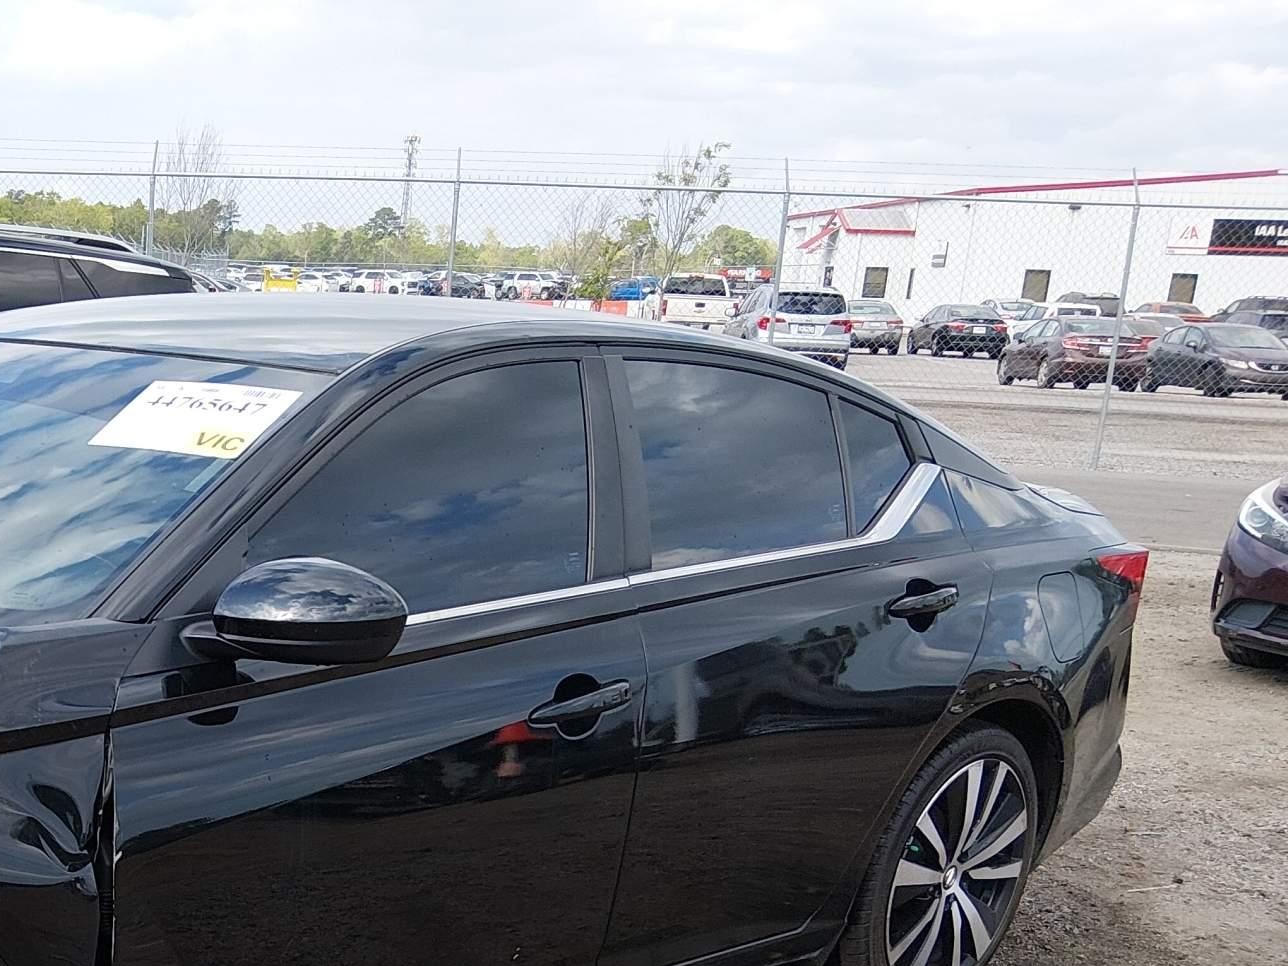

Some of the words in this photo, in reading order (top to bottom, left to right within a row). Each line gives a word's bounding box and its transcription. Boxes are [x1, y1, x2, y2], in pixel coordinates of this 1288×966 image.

[1254, 224, 1276, 237] IAA
[147, 395, 268, 415] 44765647
[196, 431, 246, 452] VIC
